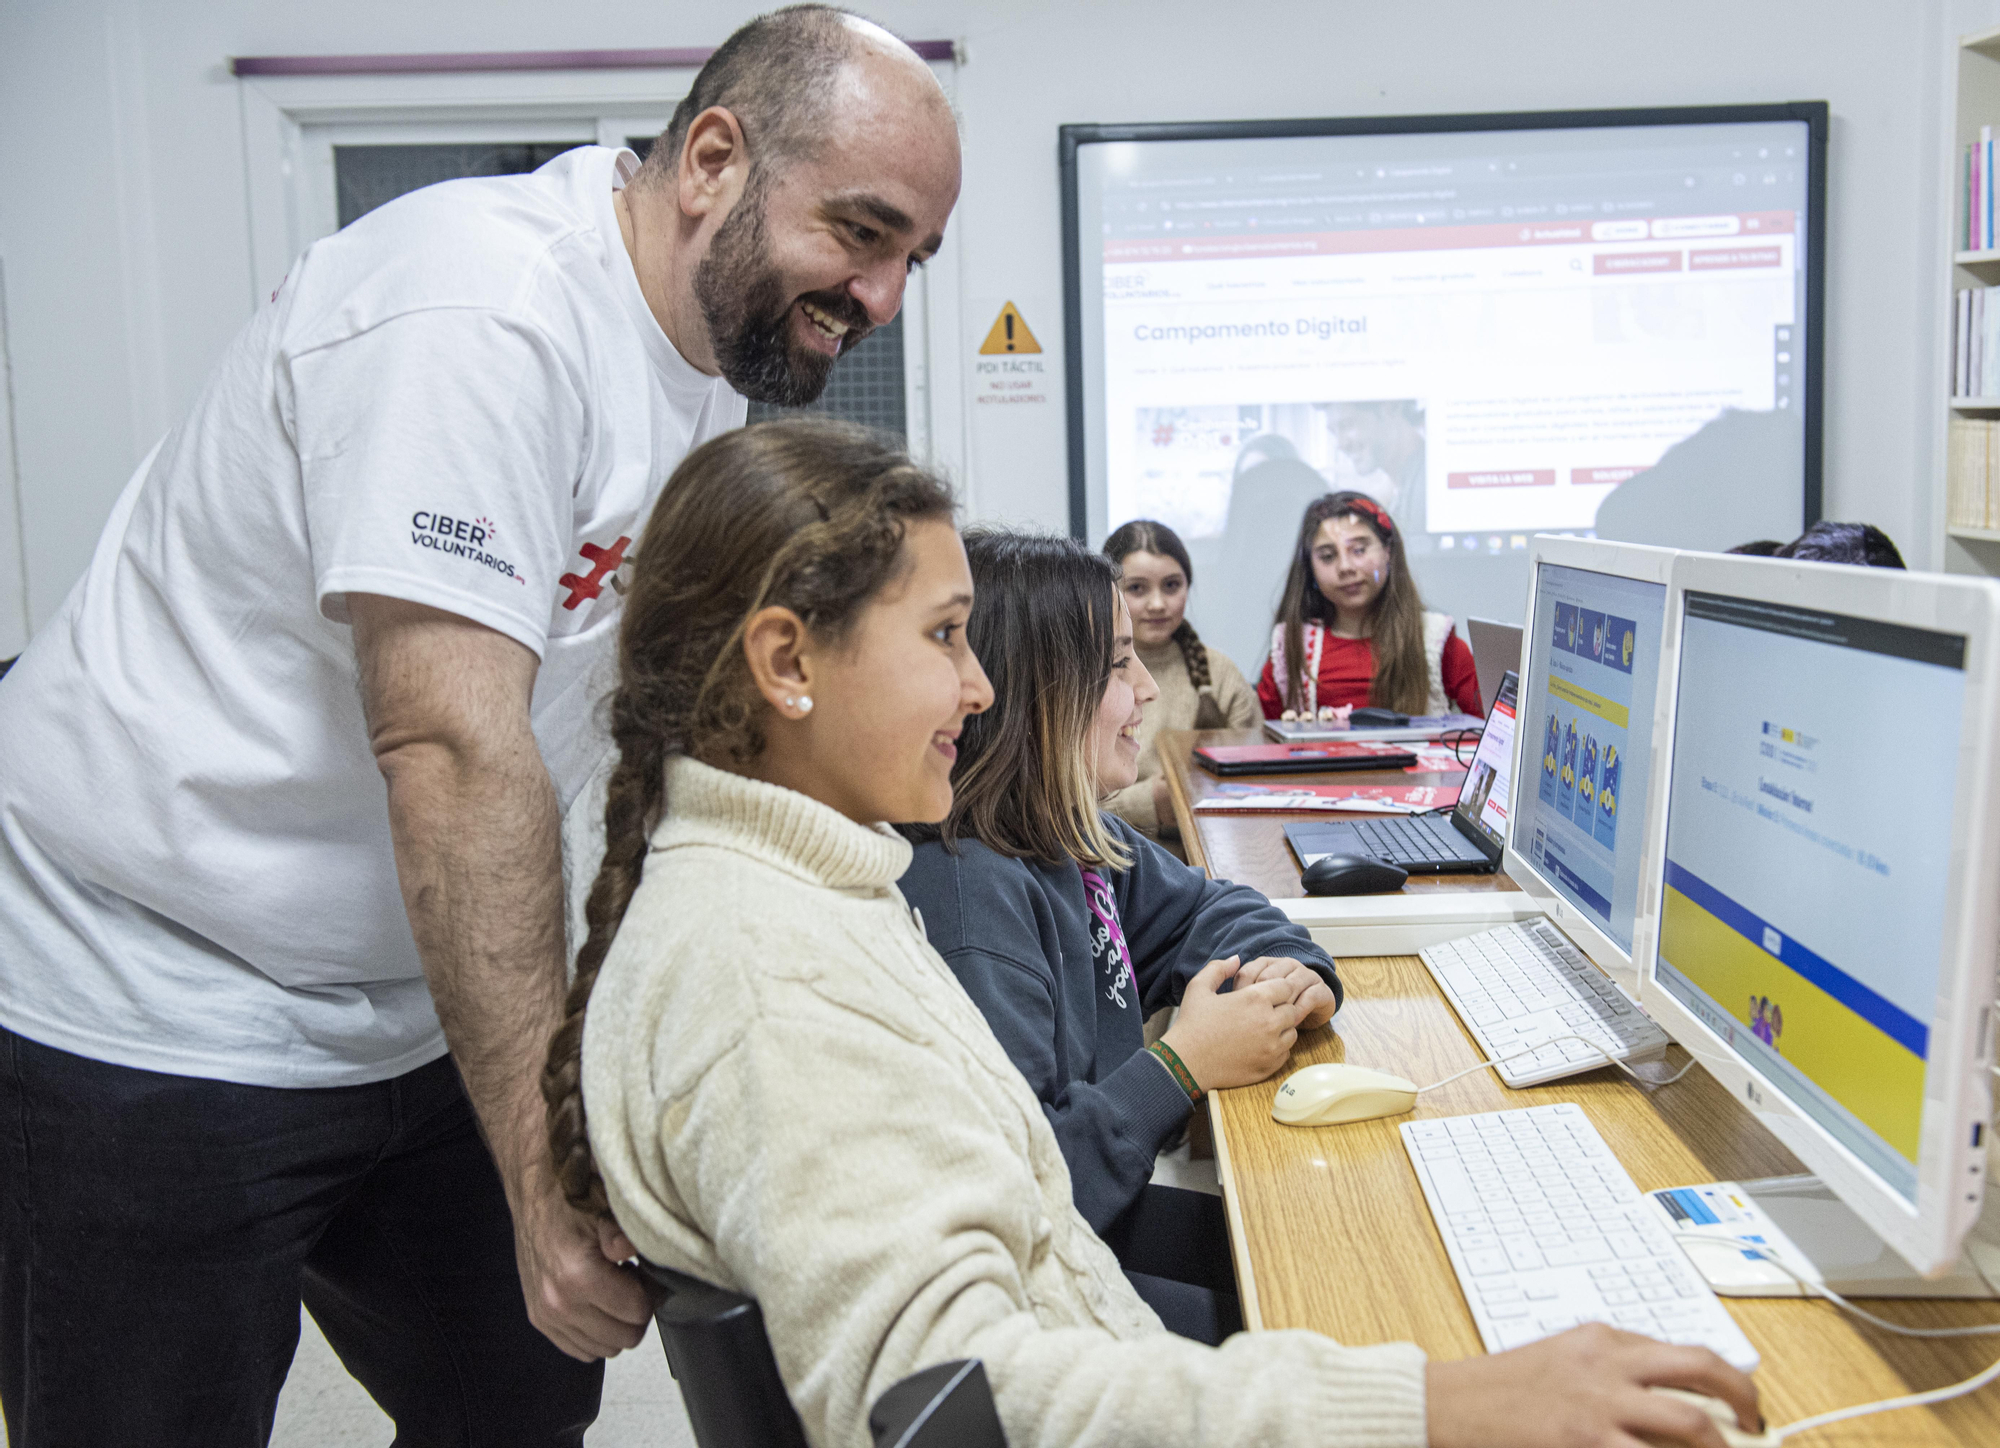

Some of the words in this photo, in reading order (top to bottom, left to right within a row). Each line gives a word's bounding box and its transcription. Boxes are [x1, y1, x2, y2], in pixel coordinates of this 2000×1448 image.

[1134, 319, 1290, 345] Campamento
[1296, 315, 1368, 341] Digital
[412, 511, 486, 547] CIBER
